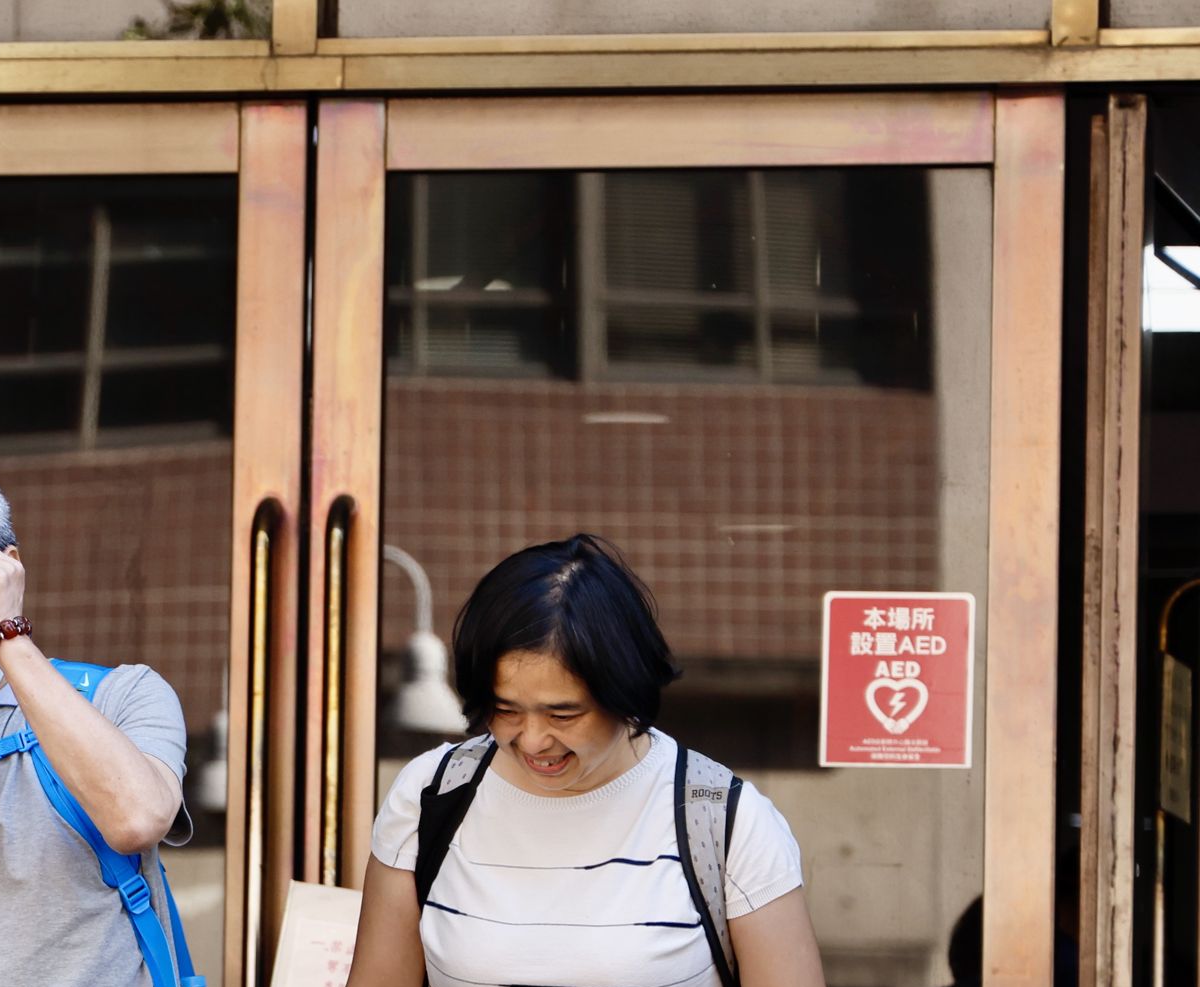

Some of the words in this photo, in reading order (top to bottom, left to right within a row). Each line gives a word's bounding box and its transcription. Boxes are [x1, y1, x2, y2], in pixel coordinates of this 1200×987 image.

[863, 606, 935, 631] 本場所
[850, 632, 947, 656] 設置AED
[875, 660, 921, 678] AED
[691, 788, 723, 800] ROOTS
